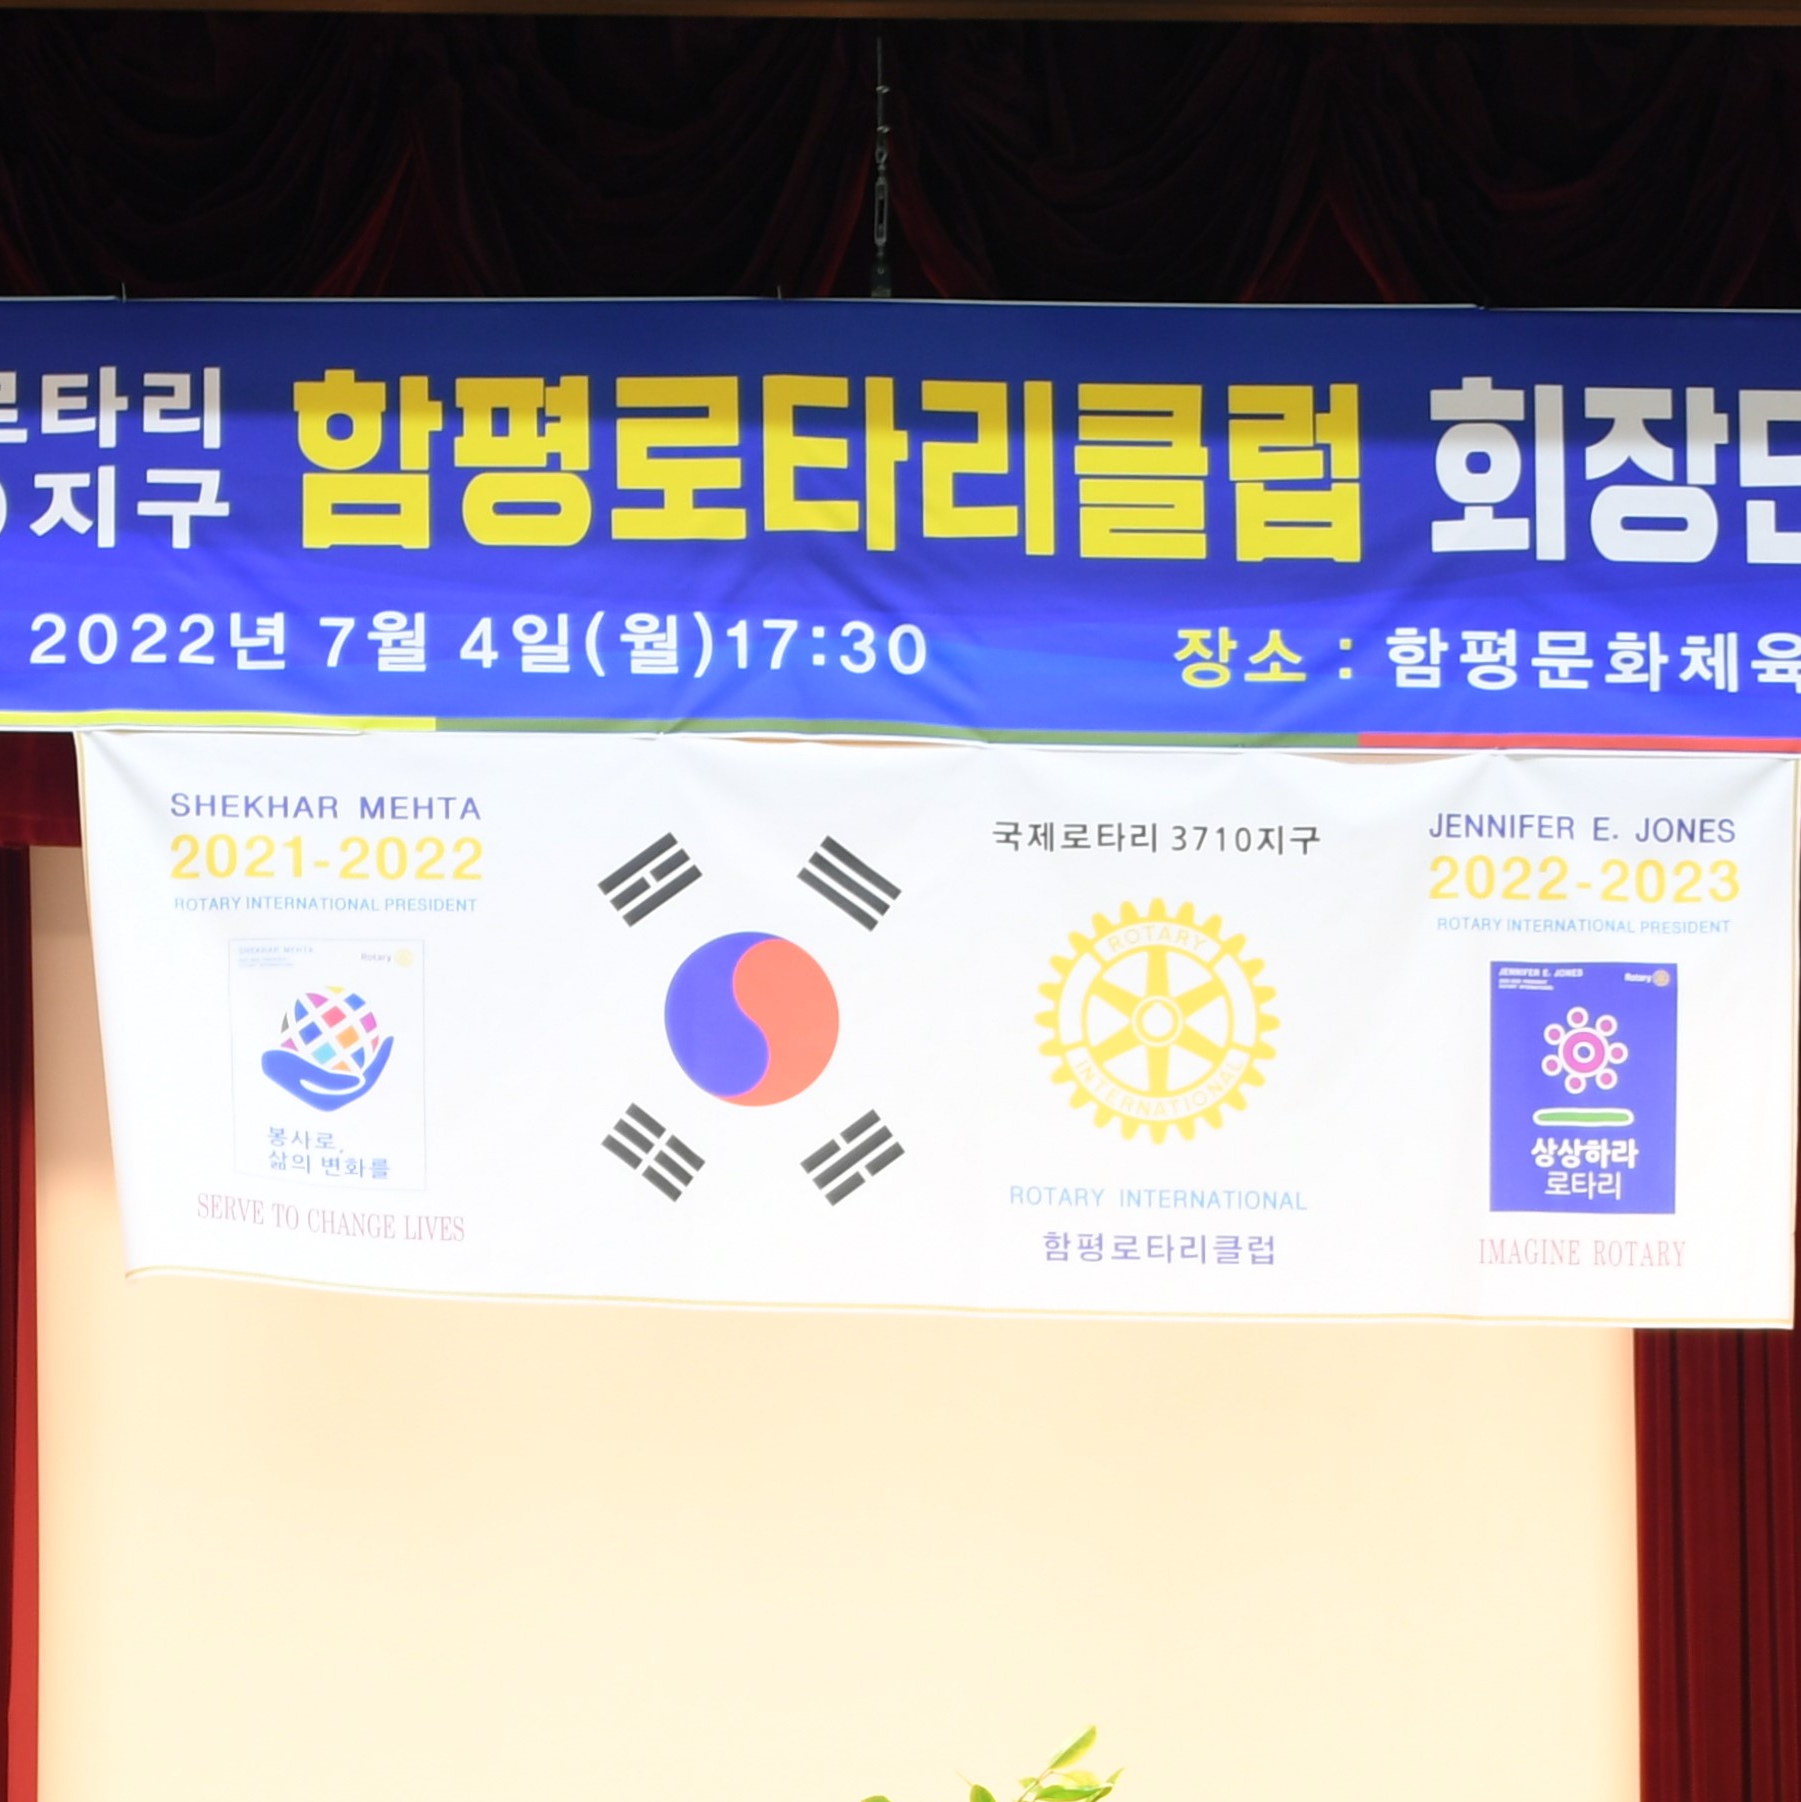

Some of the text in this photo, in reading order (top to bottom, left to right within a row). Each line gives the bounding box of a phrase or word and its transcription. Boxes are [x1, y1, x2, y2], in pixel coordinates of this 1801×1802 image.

[292, 368, 1362, 563] 함평로타리클럽
[29, 611, 290, 672] 2022년
[319, 611, 429, 673] 7월
[1173, 627, 1307, 689] 장소
[170, 792, 482, 821] SHEKHAR MEHTA
[991, 820, 1322, 858] 국제로타리 3710지구
[1428, 812, 1737, 845] JENNIFER E. JONES
[169, 832, 484, 881] 2021-2022
[1428, 854, 1742, 905] 2022-2023
[173, 896, 478, 913] ROTARY INTERNATIONAL PRESIDENT
[1106, 924, 1208, 955] ROTARY
[1436, 916, 1731, 936] ROTARY INTERNATIONAL PRESIDENT
[360, 952, 392, 963] Rotary
[1074, 1057, 1246, 1118] INTERNATIONAL
[268, 1150, 391, 1180] 삶의 변화를
[1531, 1137, 1639, 1170] 상상하라
[1009, 1185, 1309, 1212] ROTARY INTERNATIONAL
[1543, 1172, 1623, 1202] 로타리
[197, 1192, 466, 1242] SERVE TO CHANGE LIVES
[1041, 1231, 1277, 1267] 함평로타리클럽
[1478, 1237, 1687, 1270] IMAGINE ROTARY
